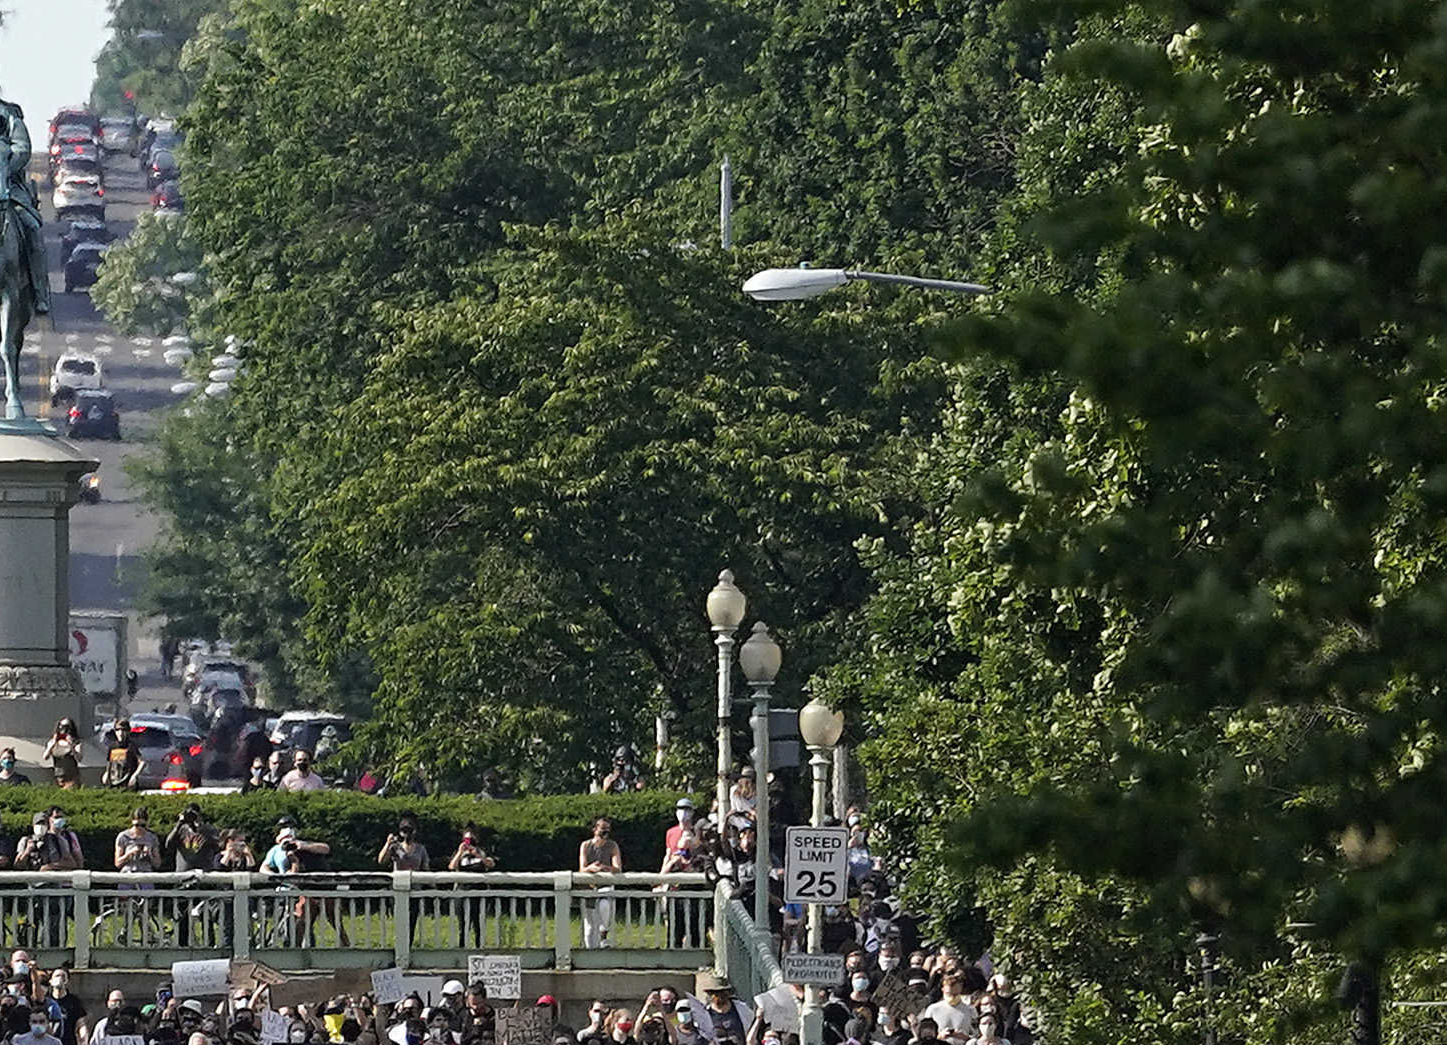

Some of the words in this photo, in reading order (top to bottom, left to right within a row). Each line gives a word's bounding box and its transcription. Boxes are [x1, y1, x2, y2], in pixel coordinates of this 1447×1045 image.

[794, 836, 842, 849] SPEED
[798, 850, 835, 863] LIMIT
[795, 870, 838, 898] 25
